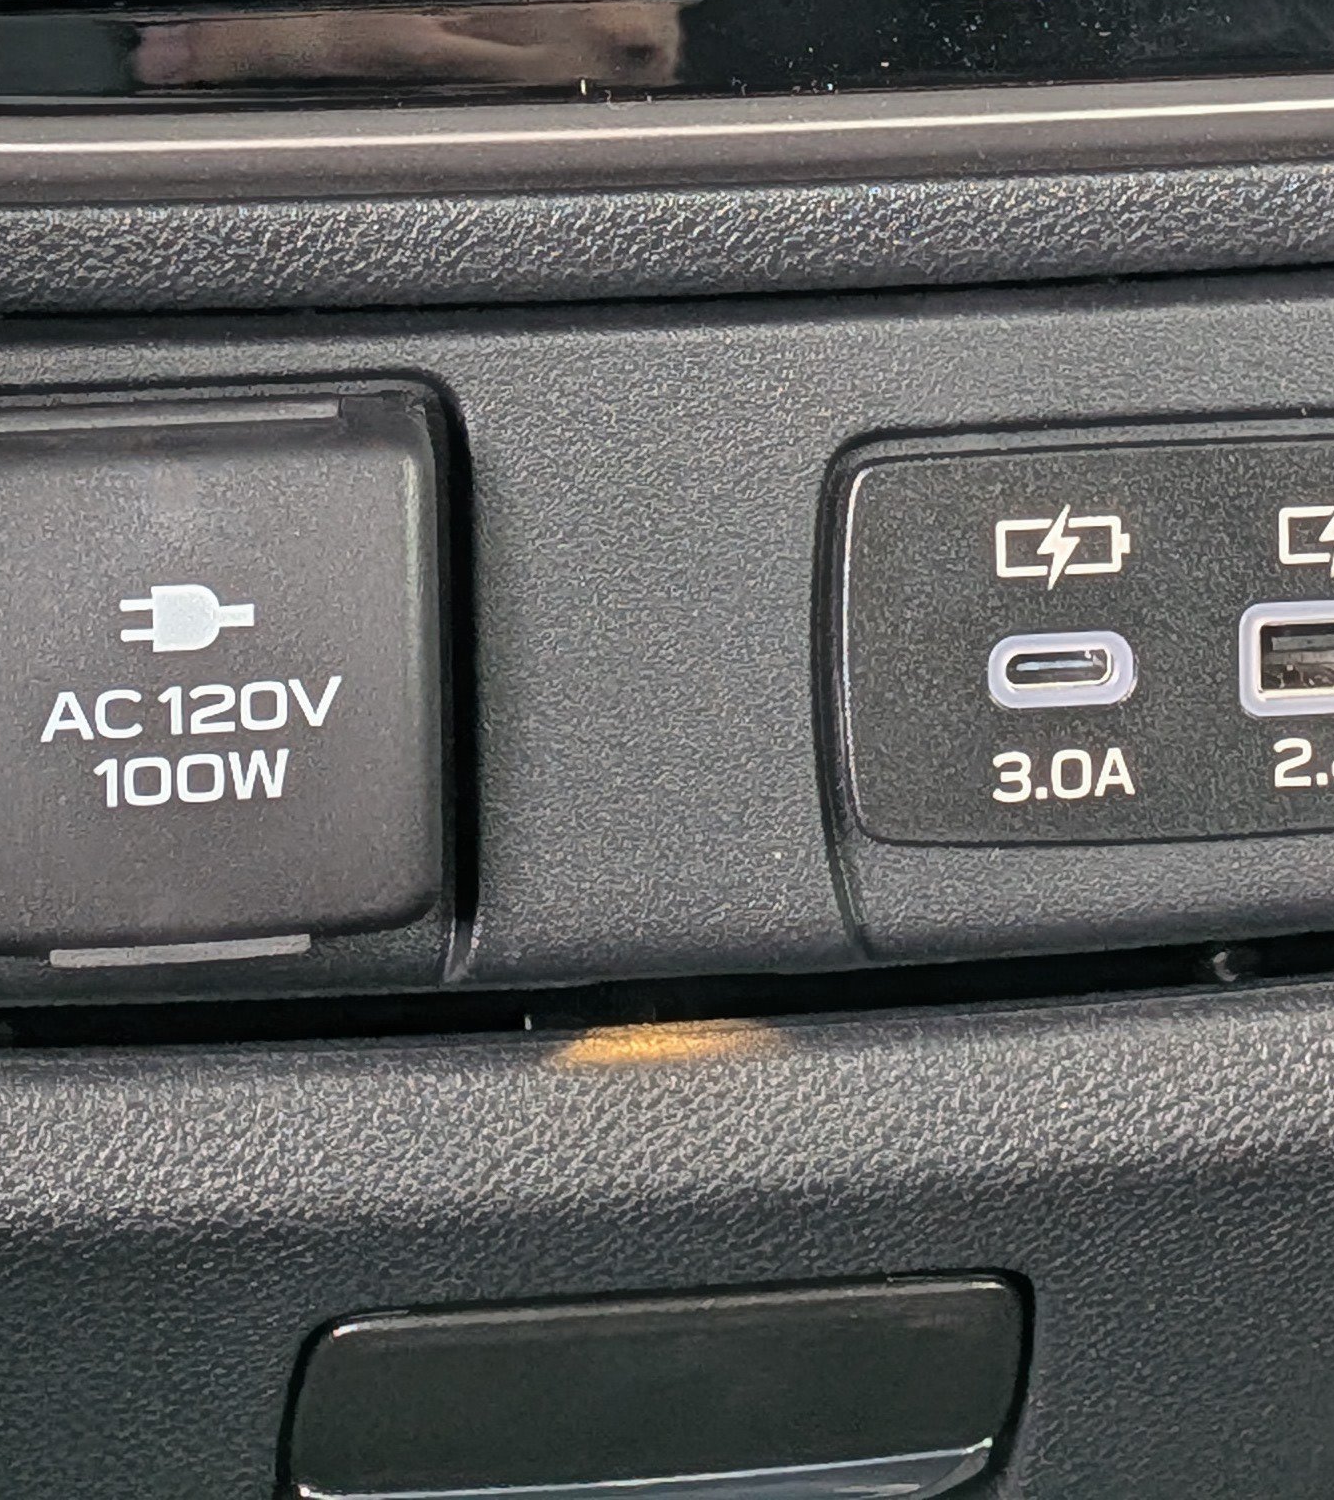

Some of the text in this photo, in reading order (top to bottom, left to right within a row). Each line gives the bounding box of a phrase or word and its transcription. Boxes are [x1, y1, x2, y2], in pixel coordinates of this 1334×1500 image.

[40, 675, 343, 743] AC 120V
[93, 748, 290, 808] 100W
[992, 747, 1136, 804] 3.0A
